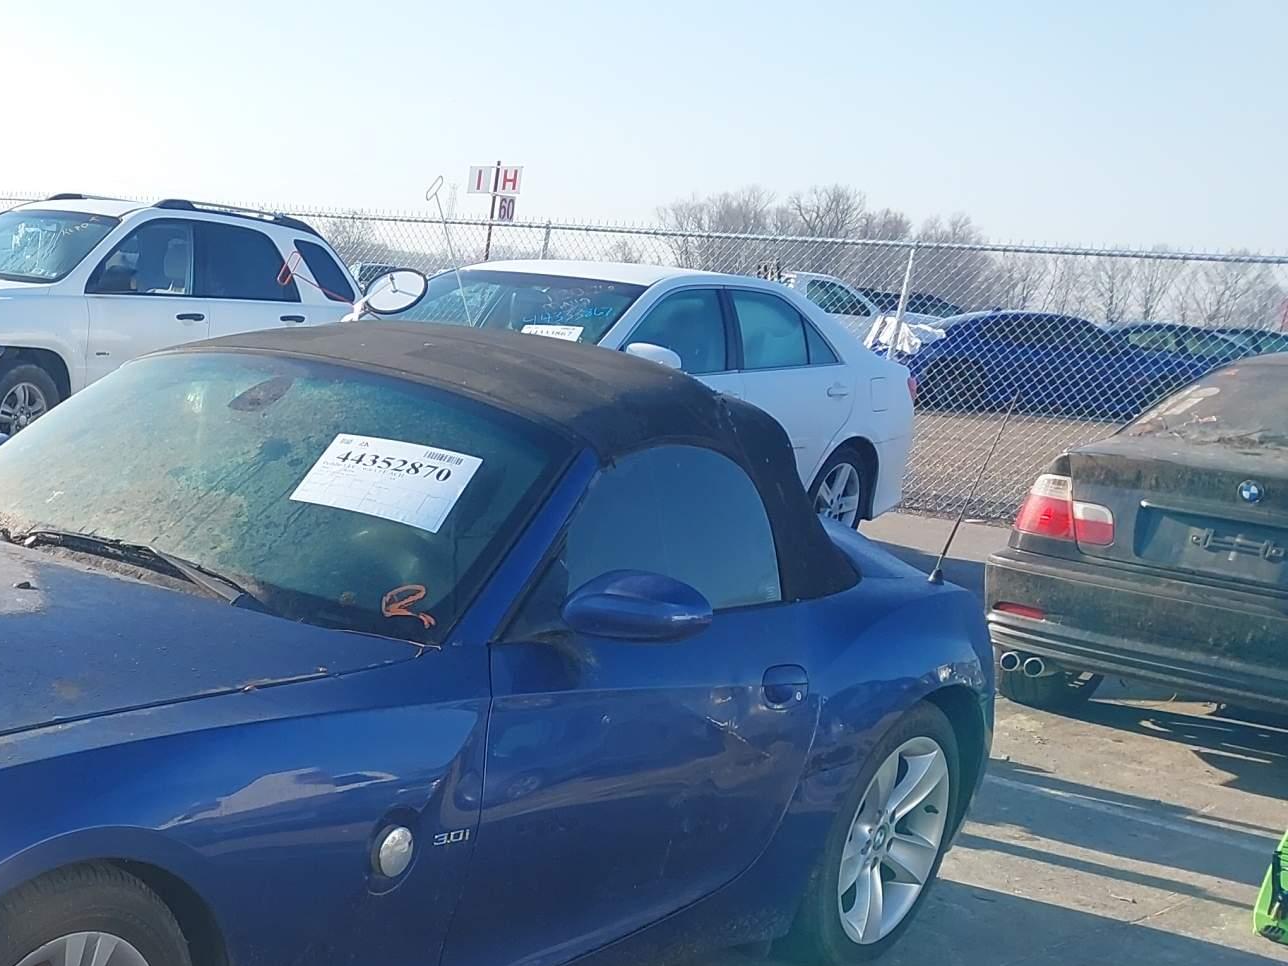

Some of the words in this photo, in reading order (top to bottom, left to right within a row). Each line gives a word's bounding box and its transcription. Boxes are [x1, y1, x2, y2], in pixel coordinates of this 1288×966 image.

[501, 169, 518, 191] H
[498, 198, 515, 220] 60
[336, 450, 452, 482] 44352870
[433, 828, 470, 846] 3.0i
